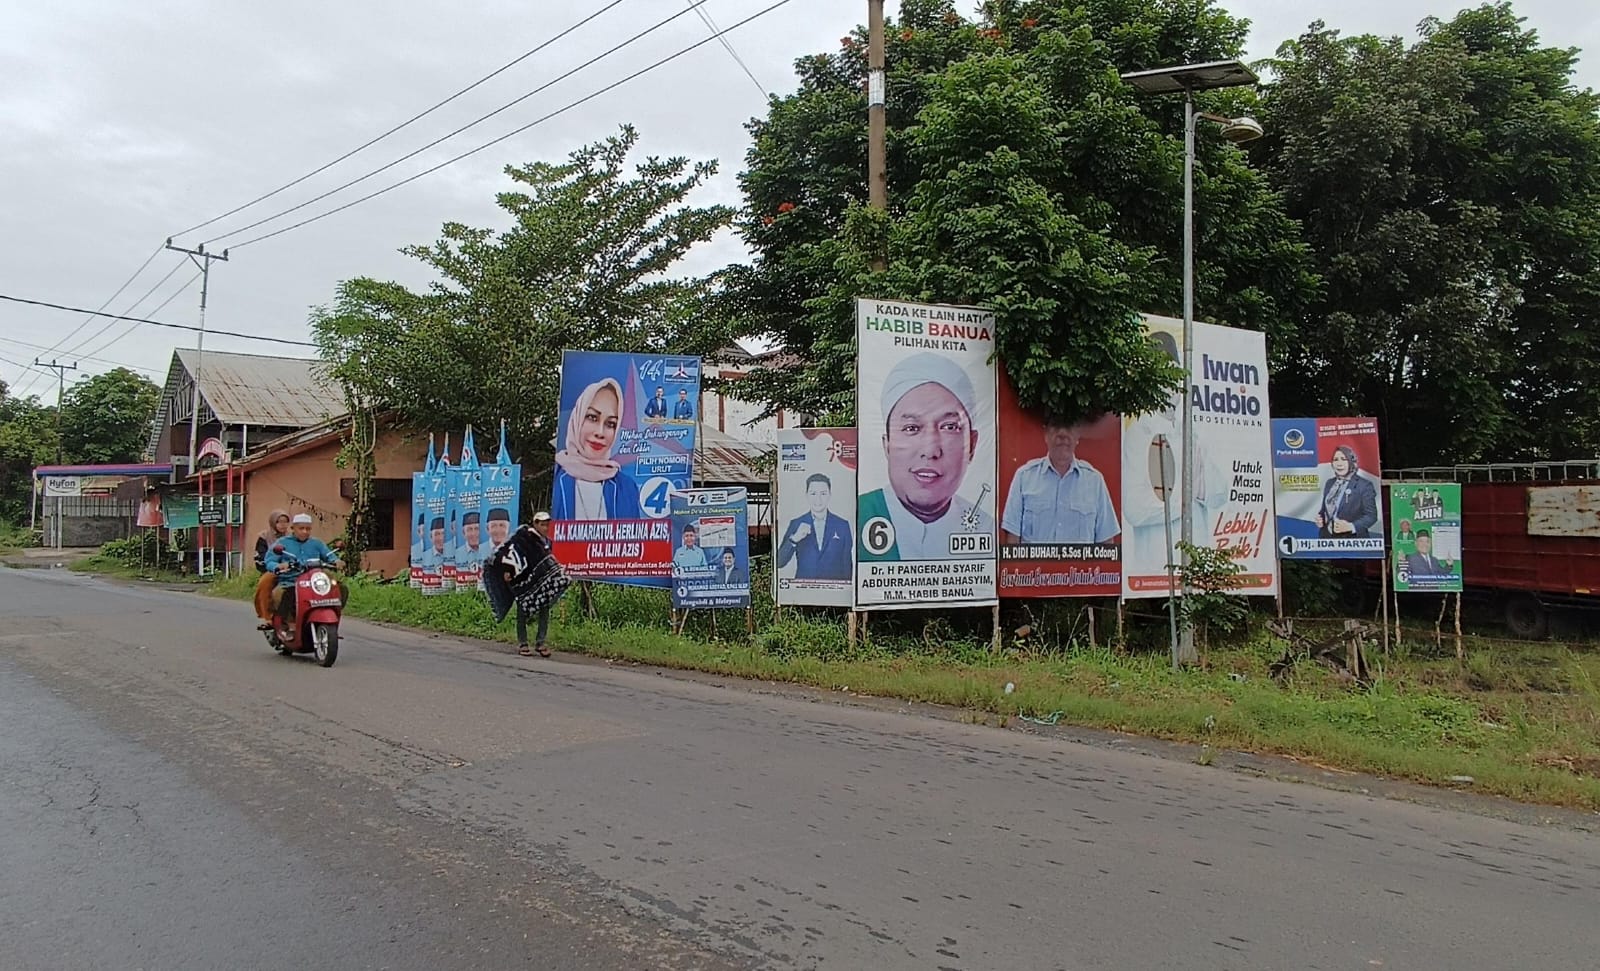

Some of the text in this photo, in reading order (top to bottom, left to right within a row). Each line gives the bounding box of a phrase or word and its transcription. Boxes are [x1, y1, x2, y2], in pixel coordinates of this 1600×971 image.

[876, 304, 909, 317] KADA
[912, 308, 927, 319] KE
[930, 309, 955, 322] LAIN
[866, 316, 991, 341] HABIB BANUA
[894, 336, 967, 352] PILIHAN KITA
[1202, 353, 1260, 386] Iwan
[1192, 384, 1261, 417] Alabio
[638, 456, 686, 465] PILIH NOMOR
[1232, 460, 1263, 474] Untuk
[489, 466, 500, 481] 7
[651, 465, 672, 473] URUT
[462, 471, 472, 486] 7
[1232, 475, 1261, 488] Masa
[644, 482, 669, 514] 4
[1229, 489, 1264, 505] Depan
[1413, 506, 1443, 521] AMIN
[1213, 511, 1258, 537] Lebih
[554, 523, 566, 541] HJ.
[567, 522, 614, 542] KAMARIATUL
[616, 522, 648, 541] HERLINA
[868, 520, 889, 551] 6
[604, 543, 621, 558] ILIN
[952, 537, 990, 551] DPD RI
[1283, 536, 1293, 554] 1
[1317, 540, 1335, 548] IDA
[1338, 539, 1382, 547] HARYATI
[1002, 547, 1011, 558] H.
[1012, 547, 1029, 558] DIDI
[1030, 546, 1061, 560] BUHARI,
[1062, 546, 1081, 558] S.Sos
[1082, 546, 1093, 560] (H.
[871, 563, 985, 576] Dr. H PANGERAN SYARIF
[862, 577, 940, 588] ABDURRAHMAN
[942, 575, 993, 586] BAHASYIM,
[883, 588, 974, 600] M.M. HABIB BANUA
